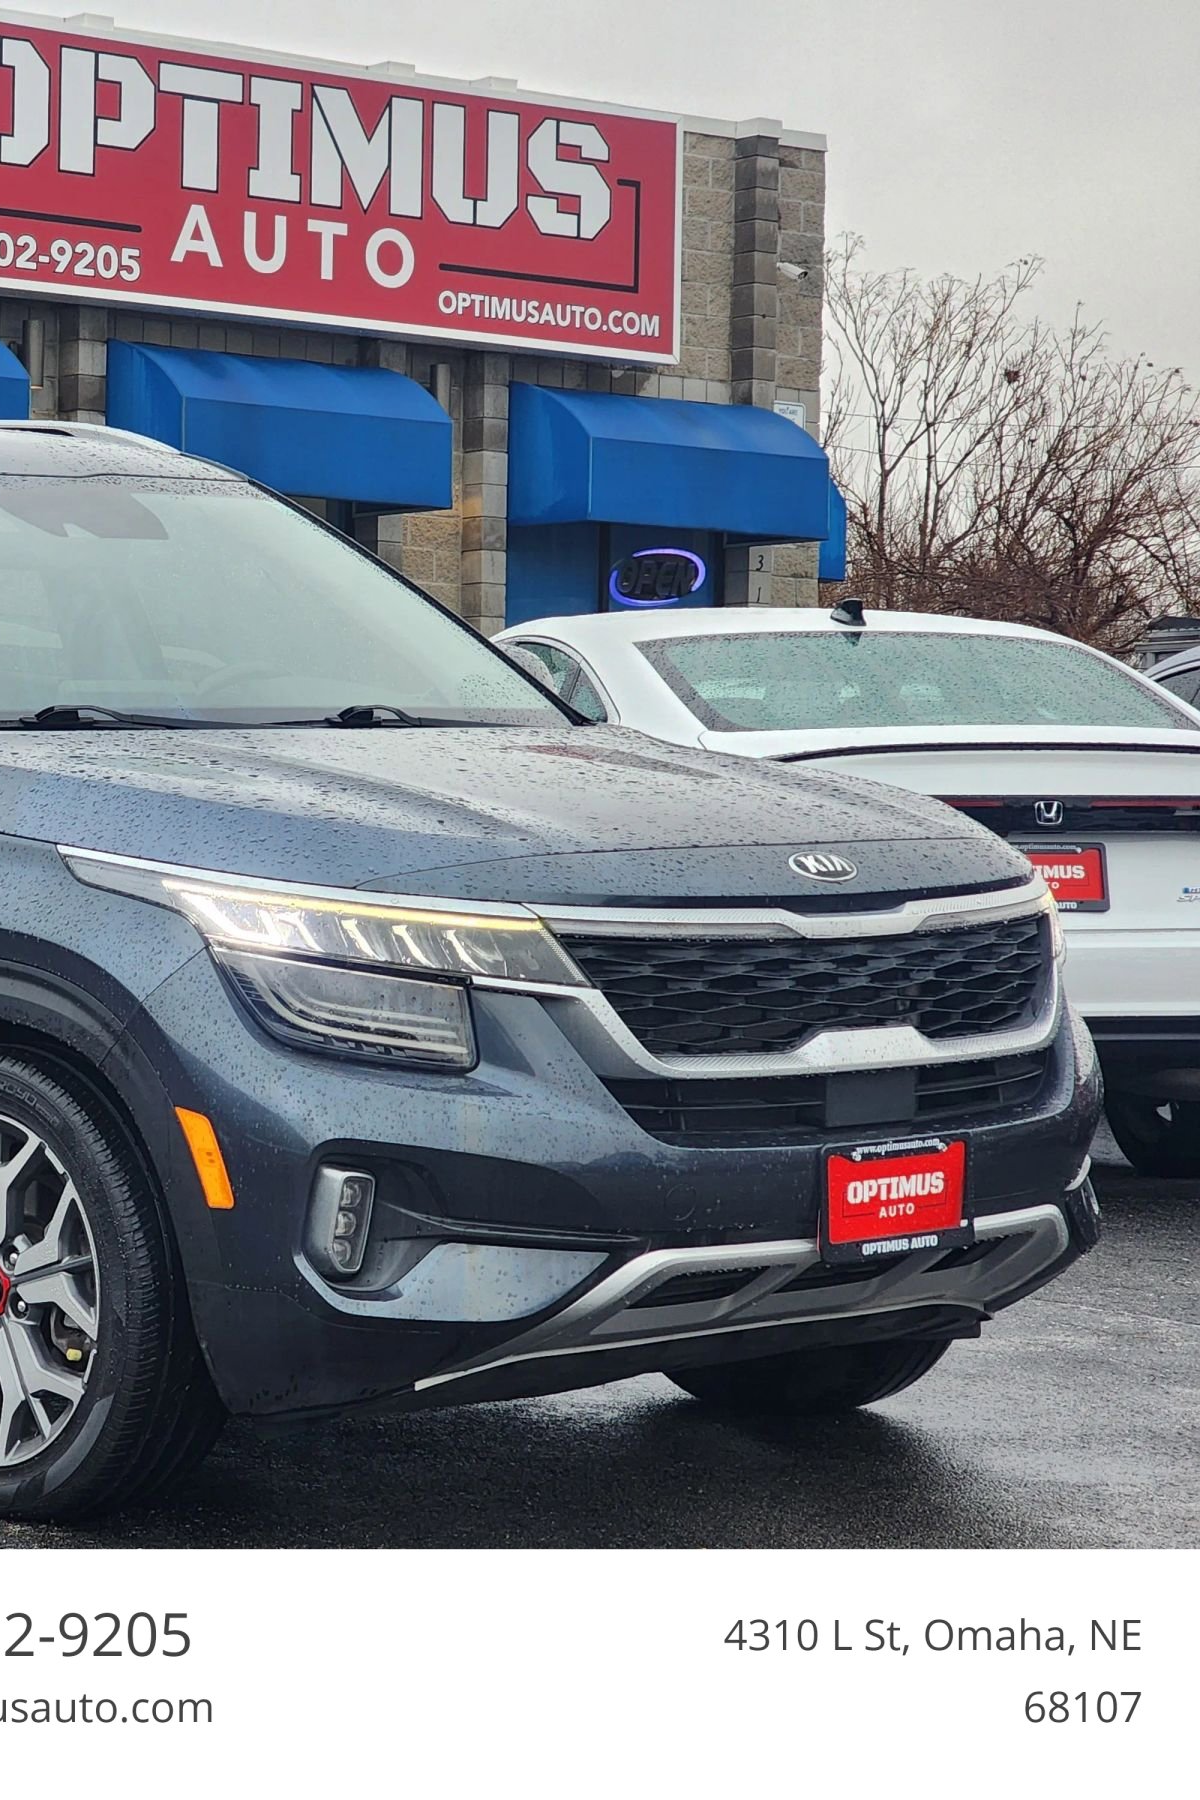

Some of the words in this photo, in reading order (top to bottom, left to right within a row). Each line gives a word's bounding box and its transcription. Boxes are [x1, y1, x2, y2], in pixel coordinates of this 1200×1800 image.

[171, 205, 416, 289] AUTO
[438, 290, 660, 337] OPTIMUSAUTO.COM
[617, 559, 694, 597] OPEN
[797, 855, 852, 873] KIA
[856, 1138, 940, 1156] www.optimusauto.com
[847, 1171, 945, 1205] OPTIMUS
[879, 1202, 915, 1219] AUTO
[862, 1237, 909, 1256] OPTIMUS
[910, 1234, 938, 1250] AUTO
